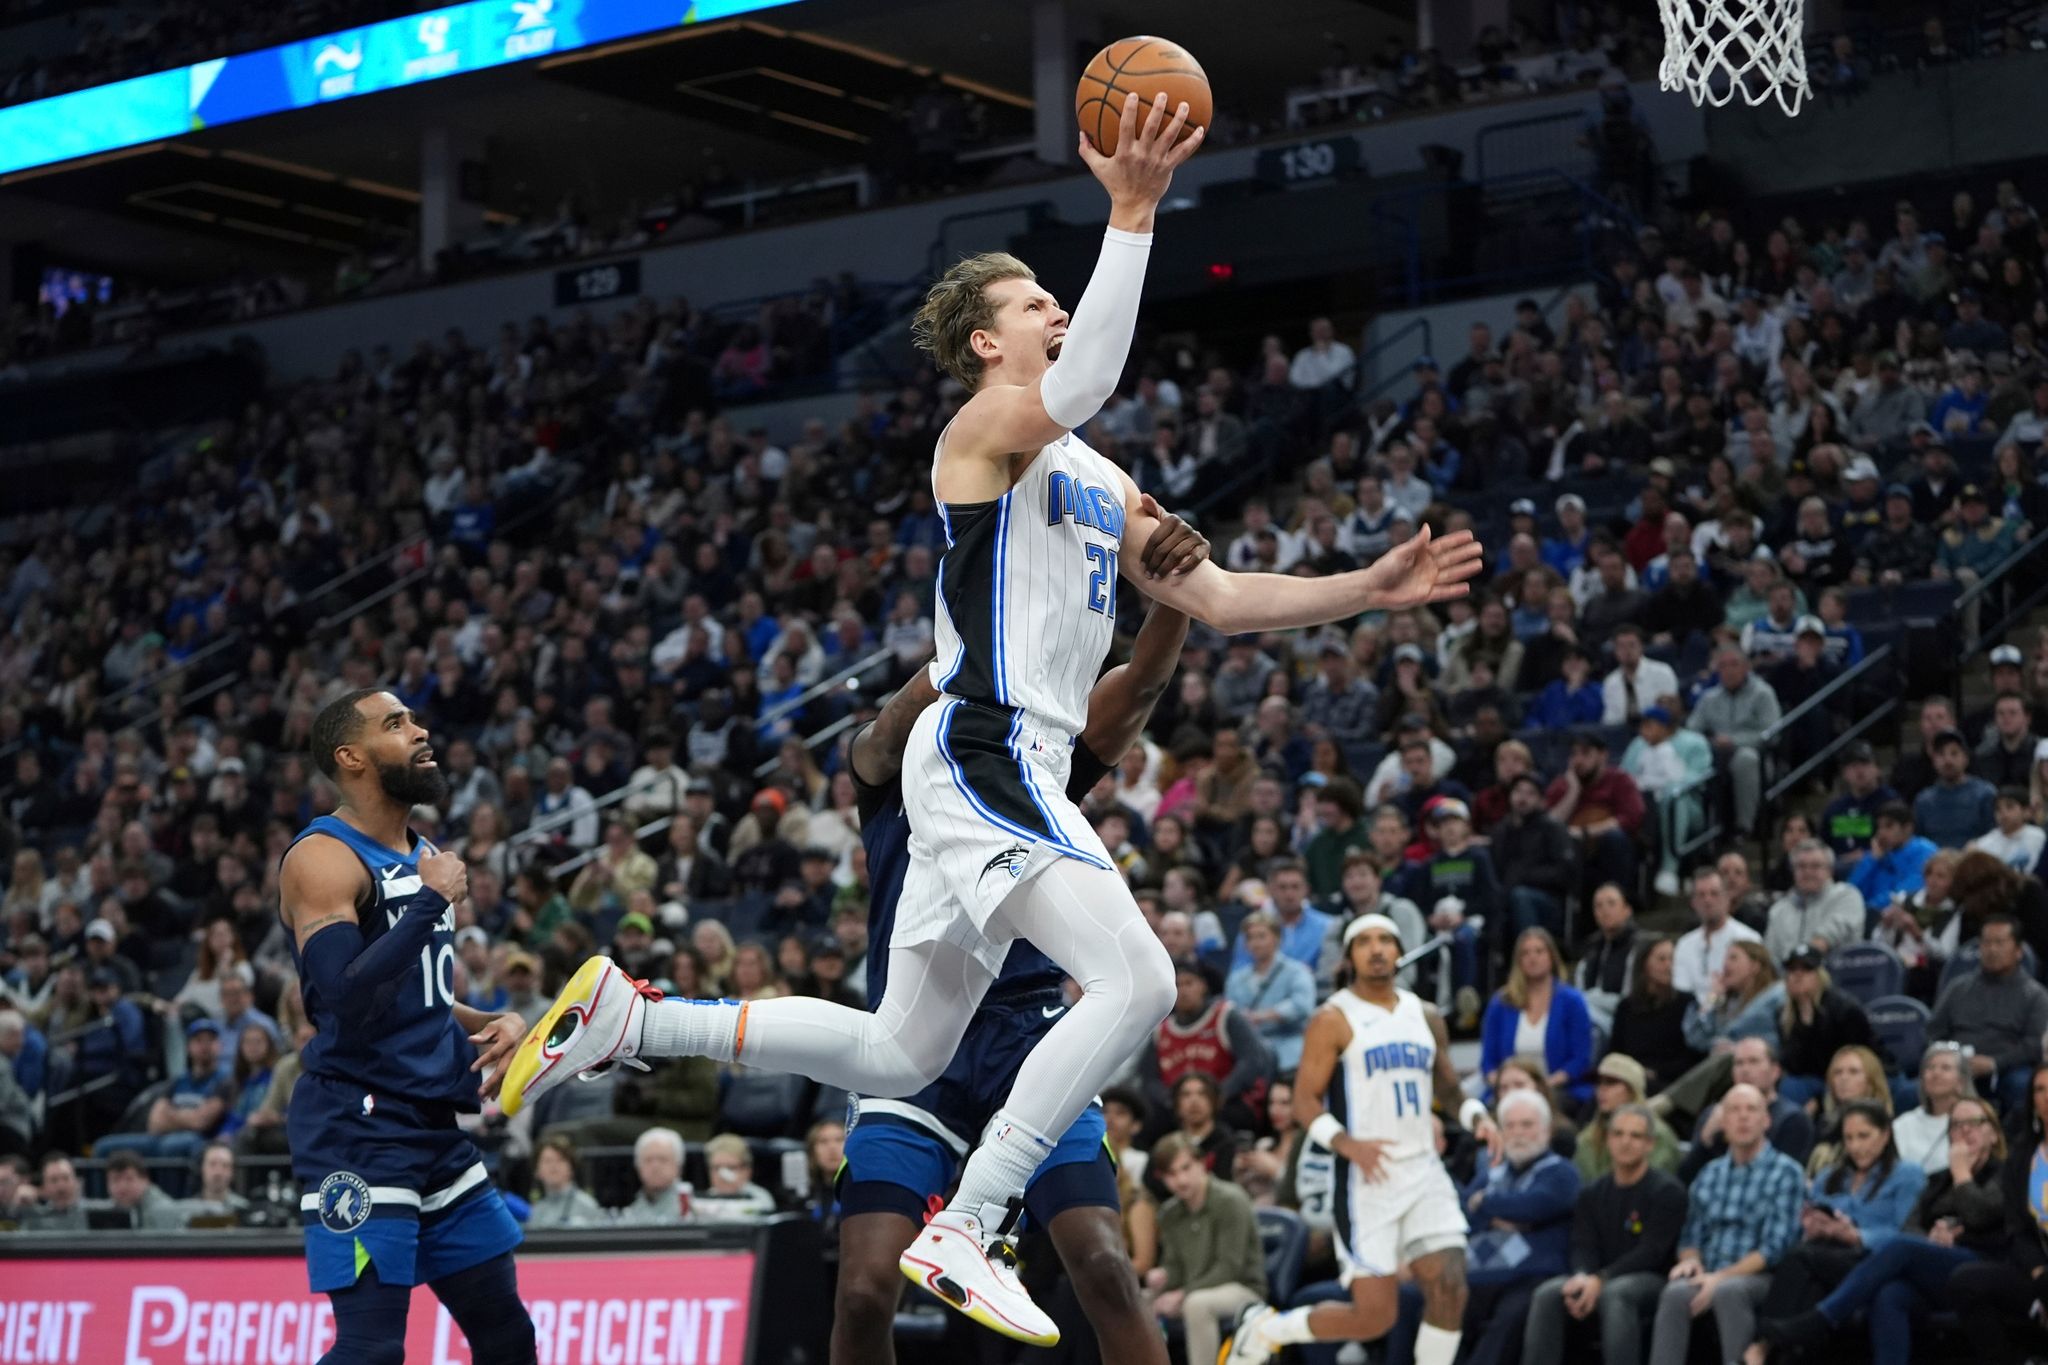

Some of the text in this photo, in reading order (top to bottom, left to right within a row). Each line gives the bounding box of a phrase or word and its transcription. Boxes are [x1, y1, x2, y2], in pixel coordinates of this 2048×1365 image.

[1282, 144, 1334, 179] 130
[576, 267, 620, 298] 129
[1085, 541, 1118, 619] 21
[421, 943, 456, 1008] 10
[1365, 1042, 1431, 1077] MAGIC
[1393, 1081, 1420, 1117] 14
[0, 1285, 743, 1365] IENT PERFICIE RFICIENT
